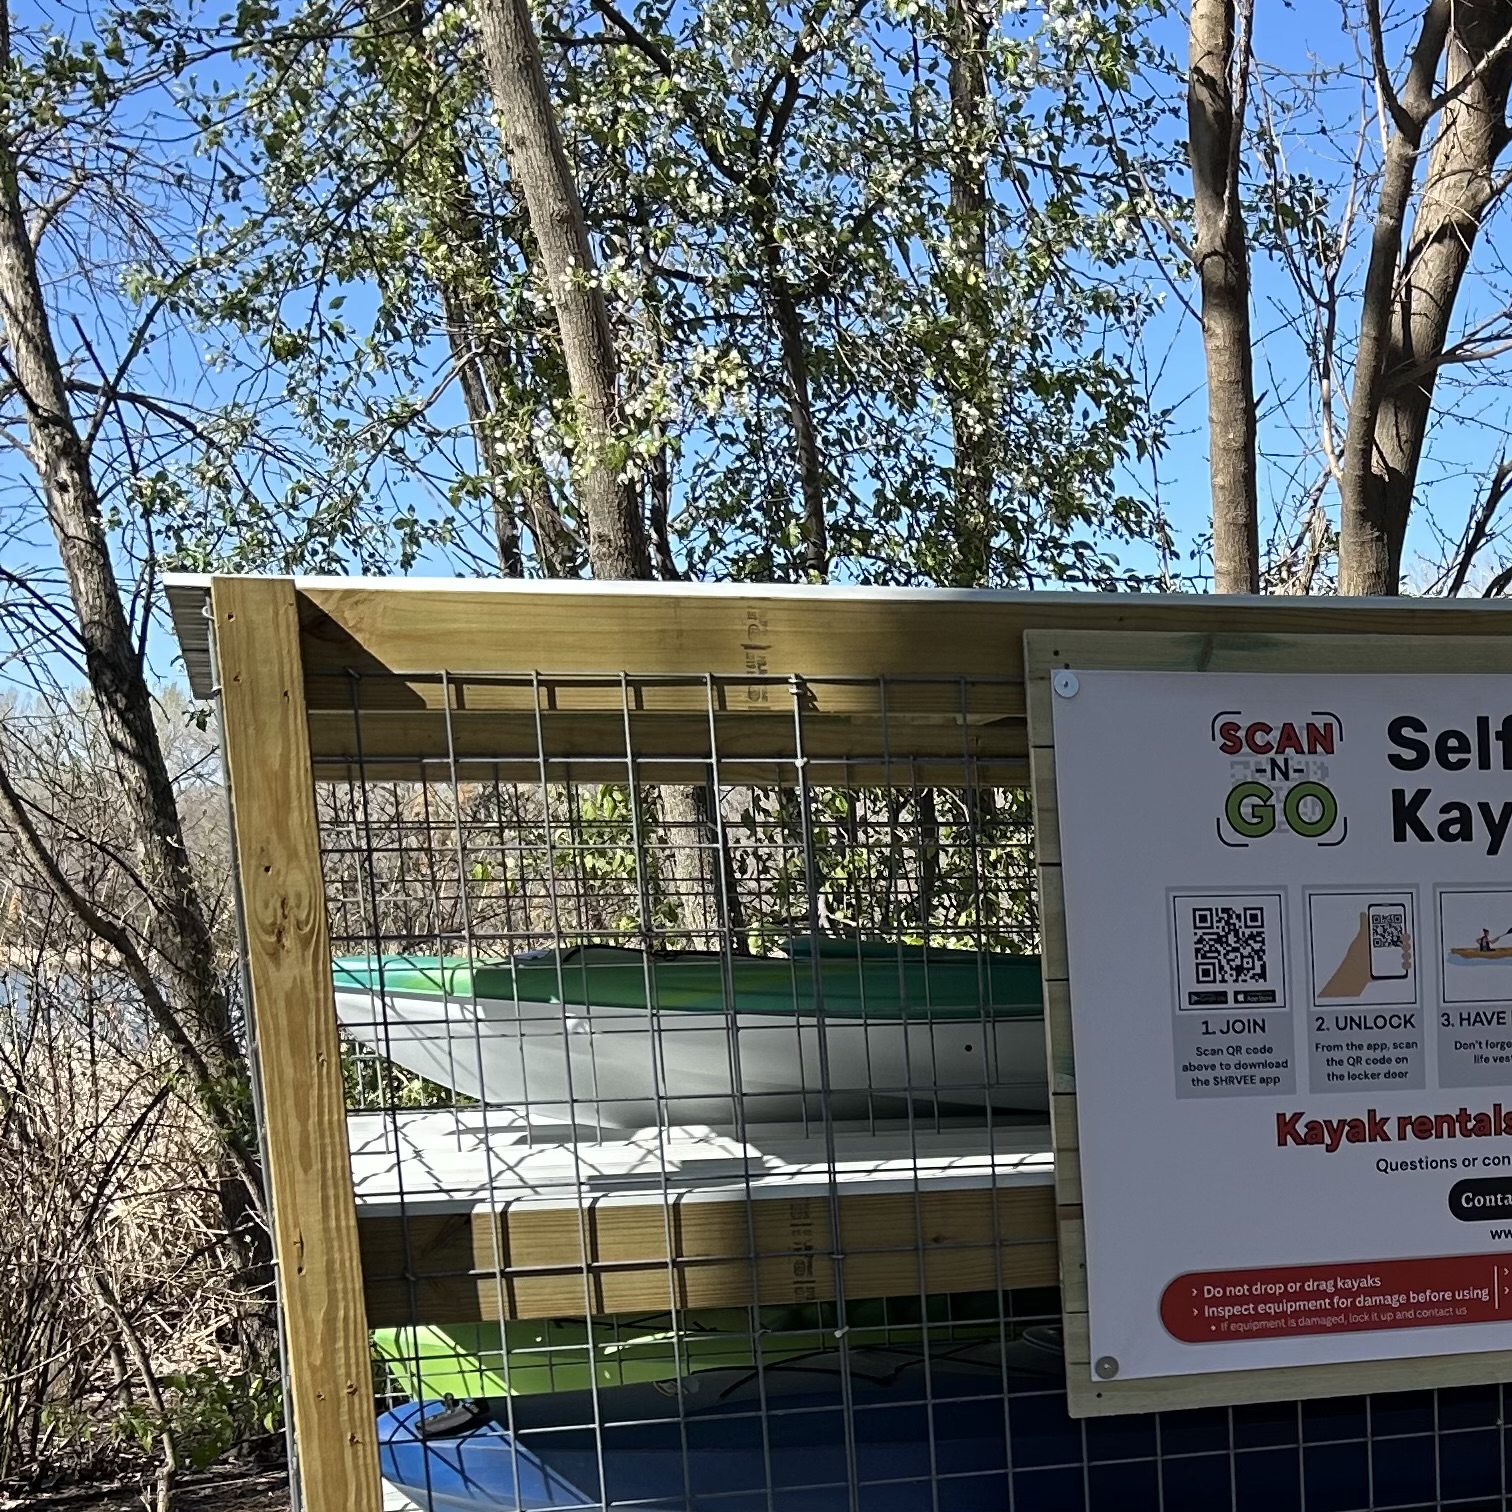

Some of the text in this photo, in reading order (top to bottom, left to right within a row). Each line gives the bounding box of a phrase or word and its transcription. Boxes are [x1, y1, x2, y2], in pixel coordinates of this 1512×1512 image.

[1219, 722, 1334, 754] SCAN
[1255, 758, 1304, 781] -N-
[1225, 781, 1338, 838] GO
[1201, 1018, 1266, 1035] 1. JOIN
[1315, 1014, 1416, 1032] 2. UNLOCK
[1441, 1013, 1455, 1028] 3.
[1459, 1010, 1506, 1026] HAVE
[1195, 1045, 1273, 1056] Scan QR code
[1315, 1043, 1343, 1052] From
[1345, 1042, 1363, 1051] the
[1392, 1040, 1418, 1050] scan
[1182, 1059, 1288, 1072] above to download
[1326, 1055, 1408, 1067] the QR code on
[1474, 1054, 1490, 1064] life
[1191, 1075, 1280, 1087] the SHRVEE app
[1327, 1070, 1408, 1082] the locker door
[1276, 1109, 1392, 1153] Kayak
[1376, 1156, 1457, 1174] Questions
[1462, 1158, 1478, 1168] or
[1204, 1275, 1381, 1298] Do not drop or drag kayaks
[1204, 1287, 1489, 1319] Inspect equipment for damage before using
[1221, 1306, 1467, 1333] If equipment is damaged, lock it up and contact us
